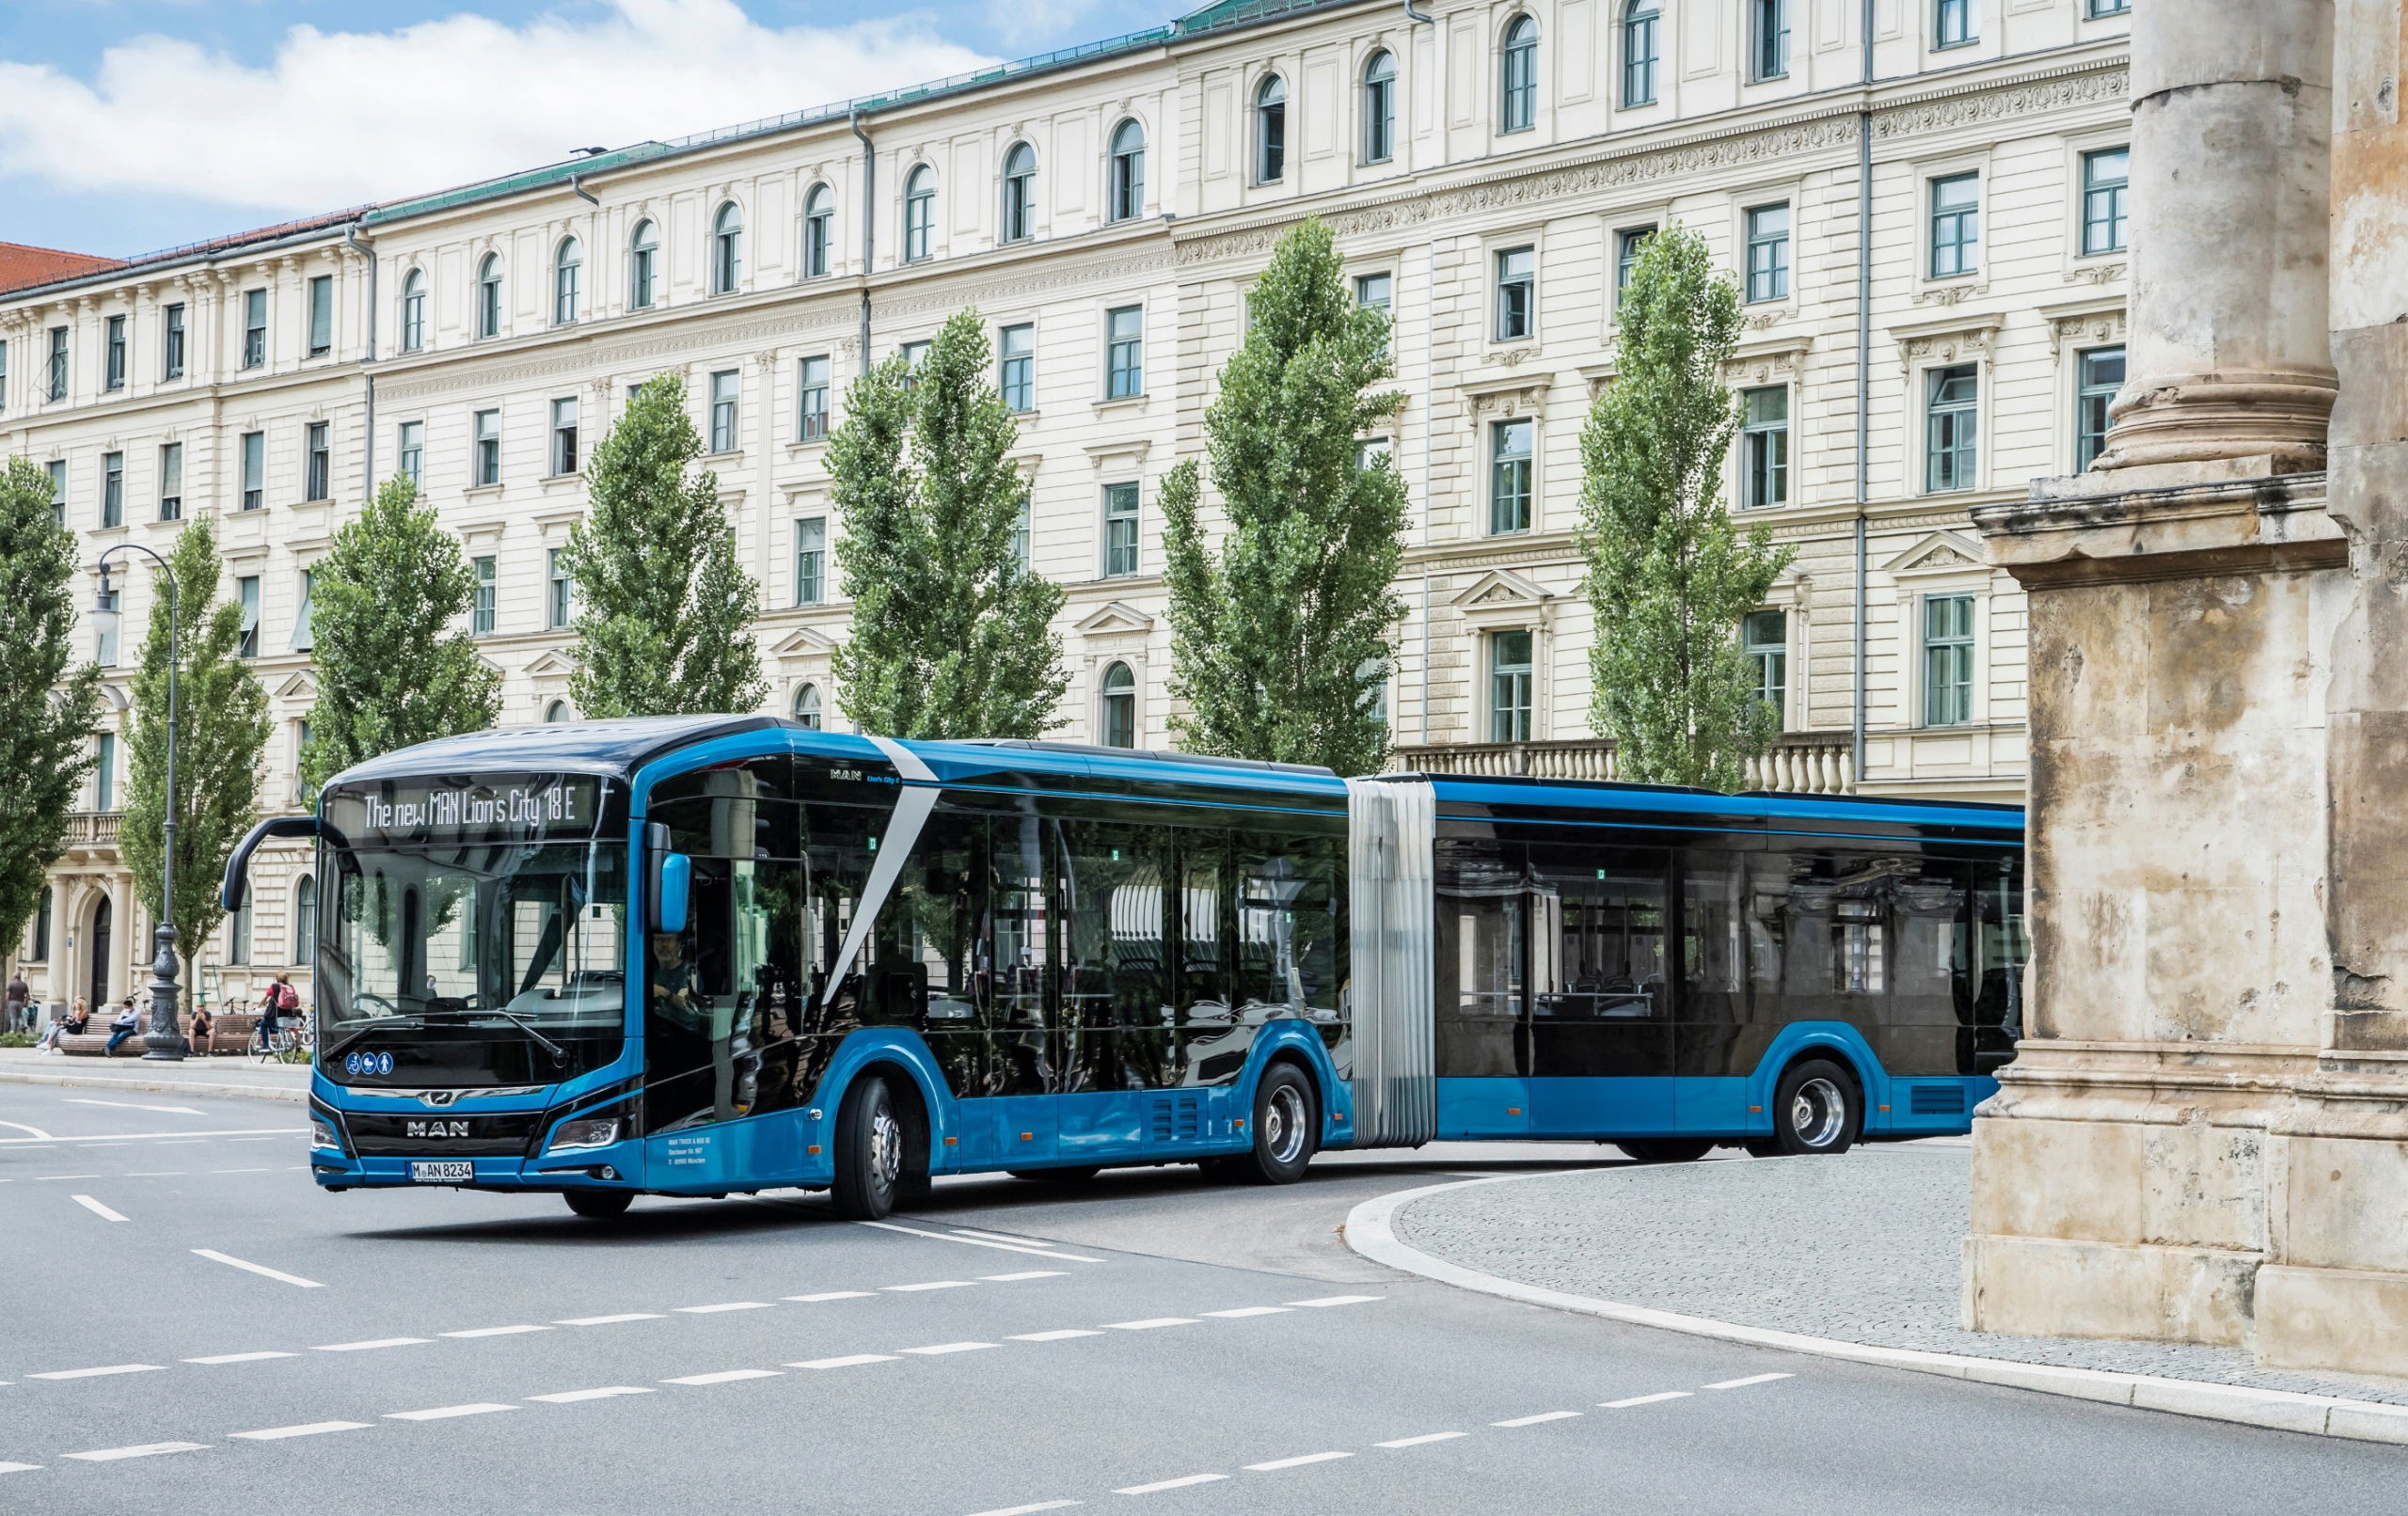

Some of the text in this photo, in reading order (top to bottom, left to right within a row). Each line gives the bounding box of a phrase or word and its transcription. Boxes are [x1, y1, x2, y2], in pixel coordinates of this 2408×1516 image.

[831, 768, 862, 782] MAN
[364, 786, 576, 828] The new MAN Lion's City 18 E
[406, 1121, 469, 1137] MAN
[413, 1163, 471, 1177] M AN 8234
